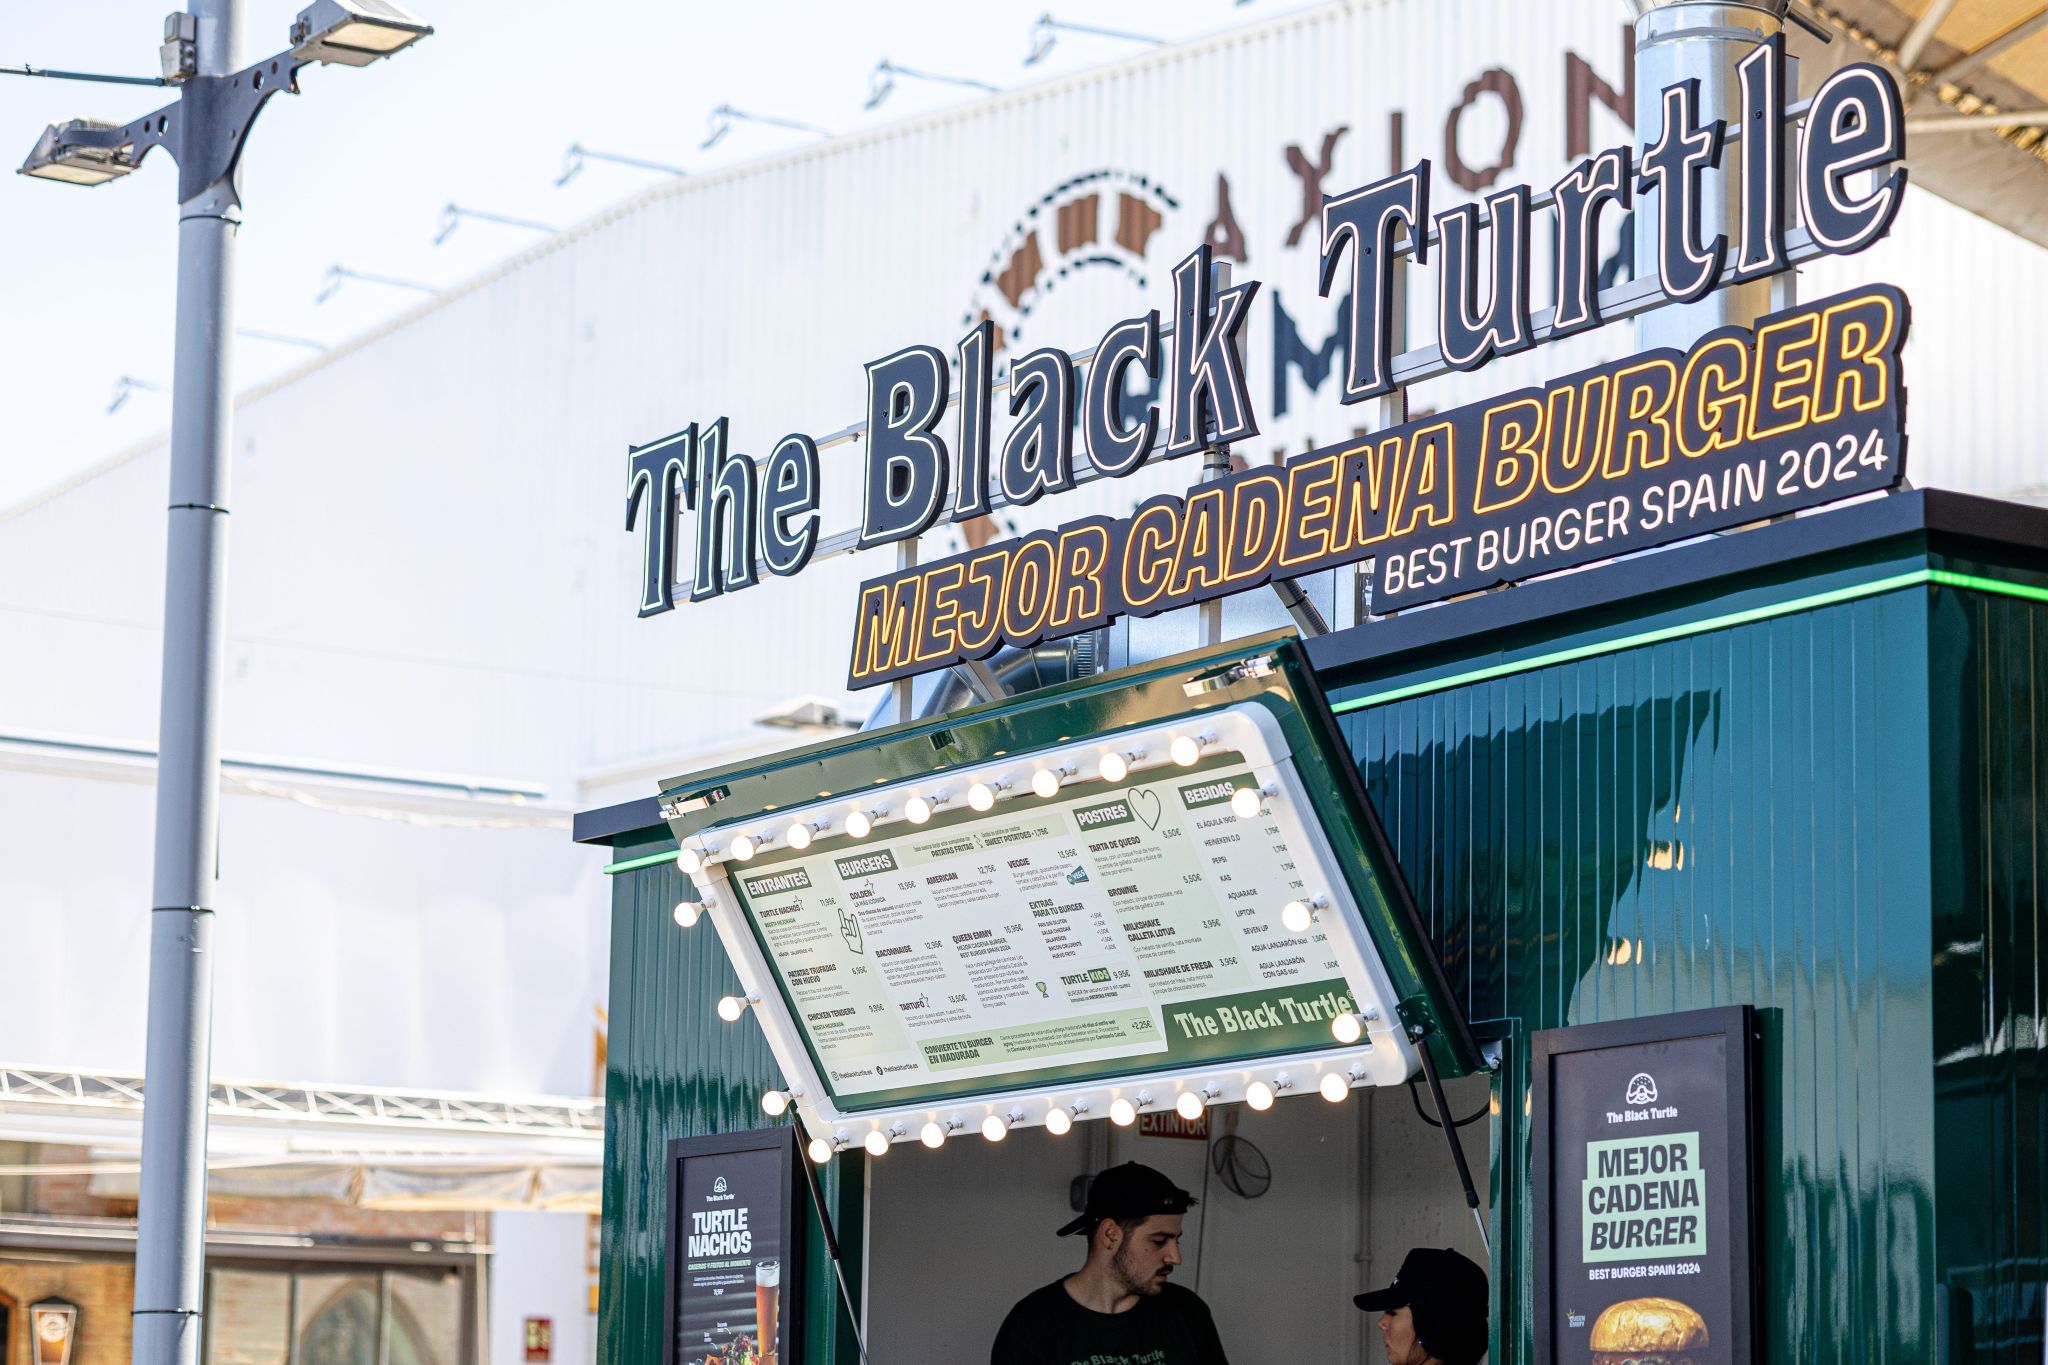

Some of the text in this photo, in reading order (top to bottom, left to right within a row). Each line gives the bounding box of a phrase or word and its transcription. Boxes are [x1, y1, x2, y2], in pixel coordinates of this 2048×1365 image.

[626, 417, 820, 618] The
[857, 244, 1262, 550] Black
[1318, 31, 1908, 405] Turtle
[852, 525, 1108, 679] MEJOR
[1121, 421, 1453, 608] CADENA
[1473, 295, 1893, 515] BURGER
[1384, 429, 1888, 595] BEST BURGER SPAIN 2024
[1183, 781, 1236, 803] BEBIDAS
[1076, 804, 1128, 825] POSTRES
[1222, 815, 1237, 823] 1900
[984, 836, 1004, 846] SWEET
[1003, 831, 1032, 842] POTATOES
[1088, 828, 1182, 852] TARTA DE QUESO 5,50€
[1203, 835, 1231, 846] HEINEKEN
[1230, 833, 1241, 842] 0,0
[930, 846, 955, 857] PATATAS
[954, 842, 974, 852] FRITAS
[1007, 848, 1078, 868] VEGGIE 13,95€
[837, 853, 892, 876] BURGERS
[1211, 855, 1227, 864] PEPSI
[746, 871, 809, 895] ENTRANTES
[925, 864, 996, 884] AMERICAN 12,75€
[849, 880, 916, 899] GOLDEN 13,95€
[1107, 873, 1202, 896] BROWNIE 5,50€
[1227, 888, 1258, 900] AQUARADE
[759, 897, 837, 918] TURTLE NACHOS 11,95€
[1028, 898, 1054, 909] EXTRAS
[1032, 908, 1050, 917] PARA
[1058, 902, 1084, 913] BURGER
[1235, 908, 1255, 916] LIPTON
[951, 923, 1024, 943] QUEEN EMMY 15,95€
[1122, 918, 1161, 931] MILKSHAKE
[1127, 930, 1155, 941] GALLETA
[1154, 927, 1176, 937] LOTUS
[1201, 918, 1221, 928] 3,95€
[1242, 926, 1261, 934] SEVEN
[875, 940, 943, 957] BACONNAISE 12,95€
[1250, 944, 1267, 952] AGUA
[1266, 938, 1297, 949] LANJARÓN
[1311, 934, 1328, 942] 1,50€
[787, 963, 837, 978] PATATAS TRUFADAS
[1143, 956, 1239, 978] MILKSHAKE DE FRESA 3,95€
[1258, 956, 1305, 969] AGUA LANJARÓN
[1261, 970, 1276, 978] CON
[1275, 968, 1288, 976] GAS
[1323, 961, 1339, 969] 1,50€
[790, 966, 868, 986] CON HUEVO 6,95€
[1060, 969, 1131, 985] TURTLE KIDS 9,95€
[898, 993, 967, 1010] TARTUFO 13,50€
[807, 1003, 884, 1020] CHICKEN TENDERS 9,95€
[1173, 1009, 1220, 1038] The
[1215, 1000, 1283, 1032] Black
[923, 1020, 1153, 1054] CONVIERTE TU BURGER +2,25€
[927, 1049, 980, 1064] EN MADURADA
[1607, 1106, 1678, 1124] The Black Turtle
[1598, 1143, 1688, 1179] MEJOR
[1588, 1178, 1700, 1215] CADENA
[692, 1207, 748, 1235] TURTLE
[1590, 1215, 1697, 1251] BURGER
[688, 1231, 751, 1258] NACHOS
[1589, 1262, 1700, 1280] BEST BURGER SPAIN 2024
